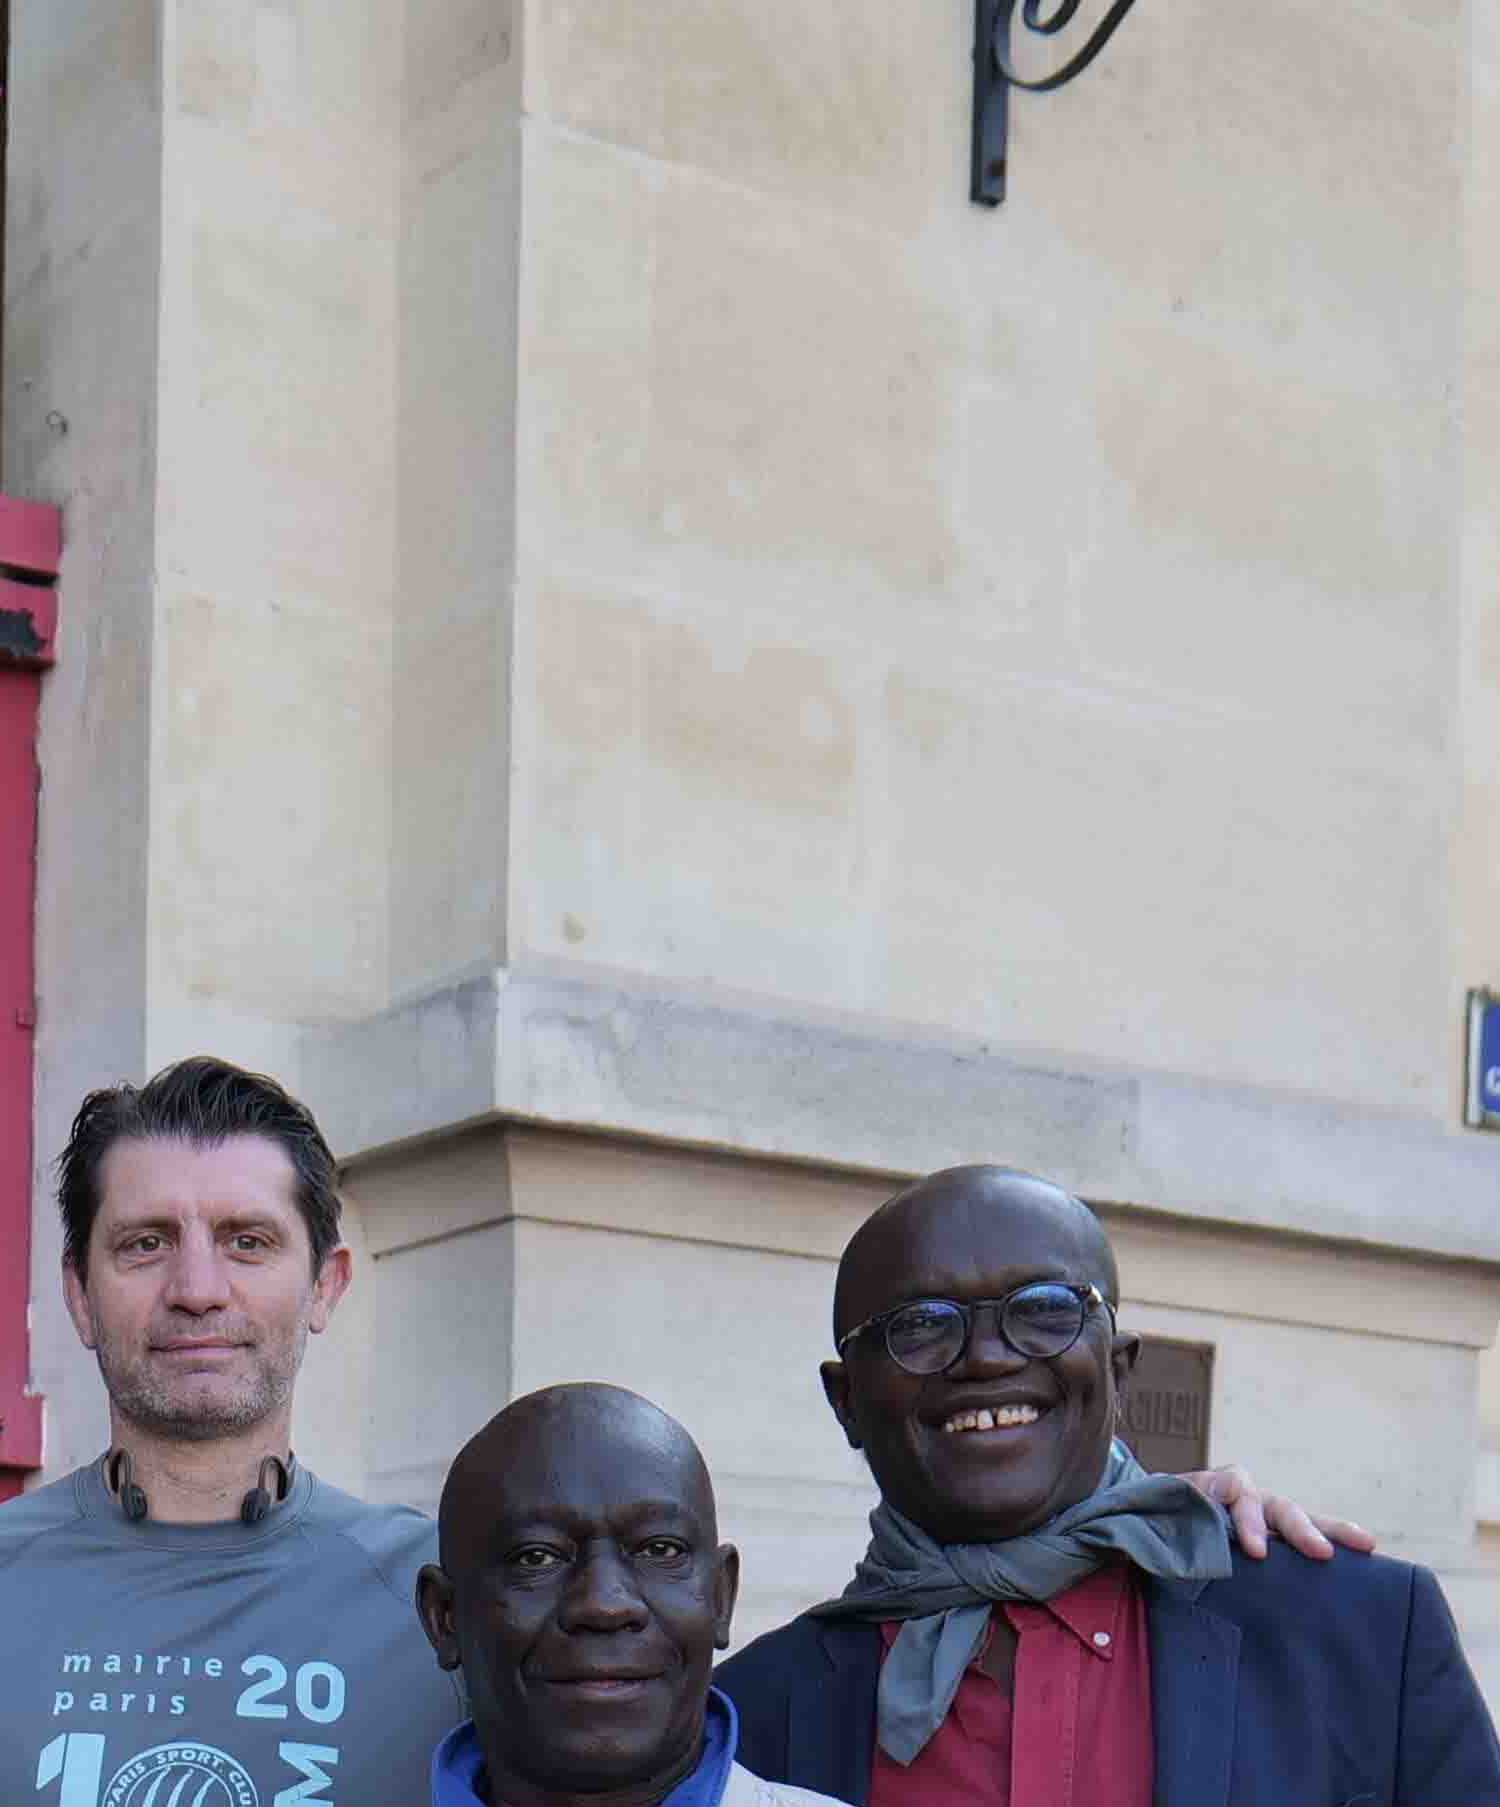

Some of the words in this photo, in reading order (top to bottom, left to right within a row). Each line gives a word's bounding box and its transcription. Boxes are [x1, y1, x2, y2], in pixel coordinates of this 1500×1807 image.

[53, 1688, 186, 1716] paris
[62, 1652, 224, 1678] mairie
[235, 1654, 346, 1724] 20
